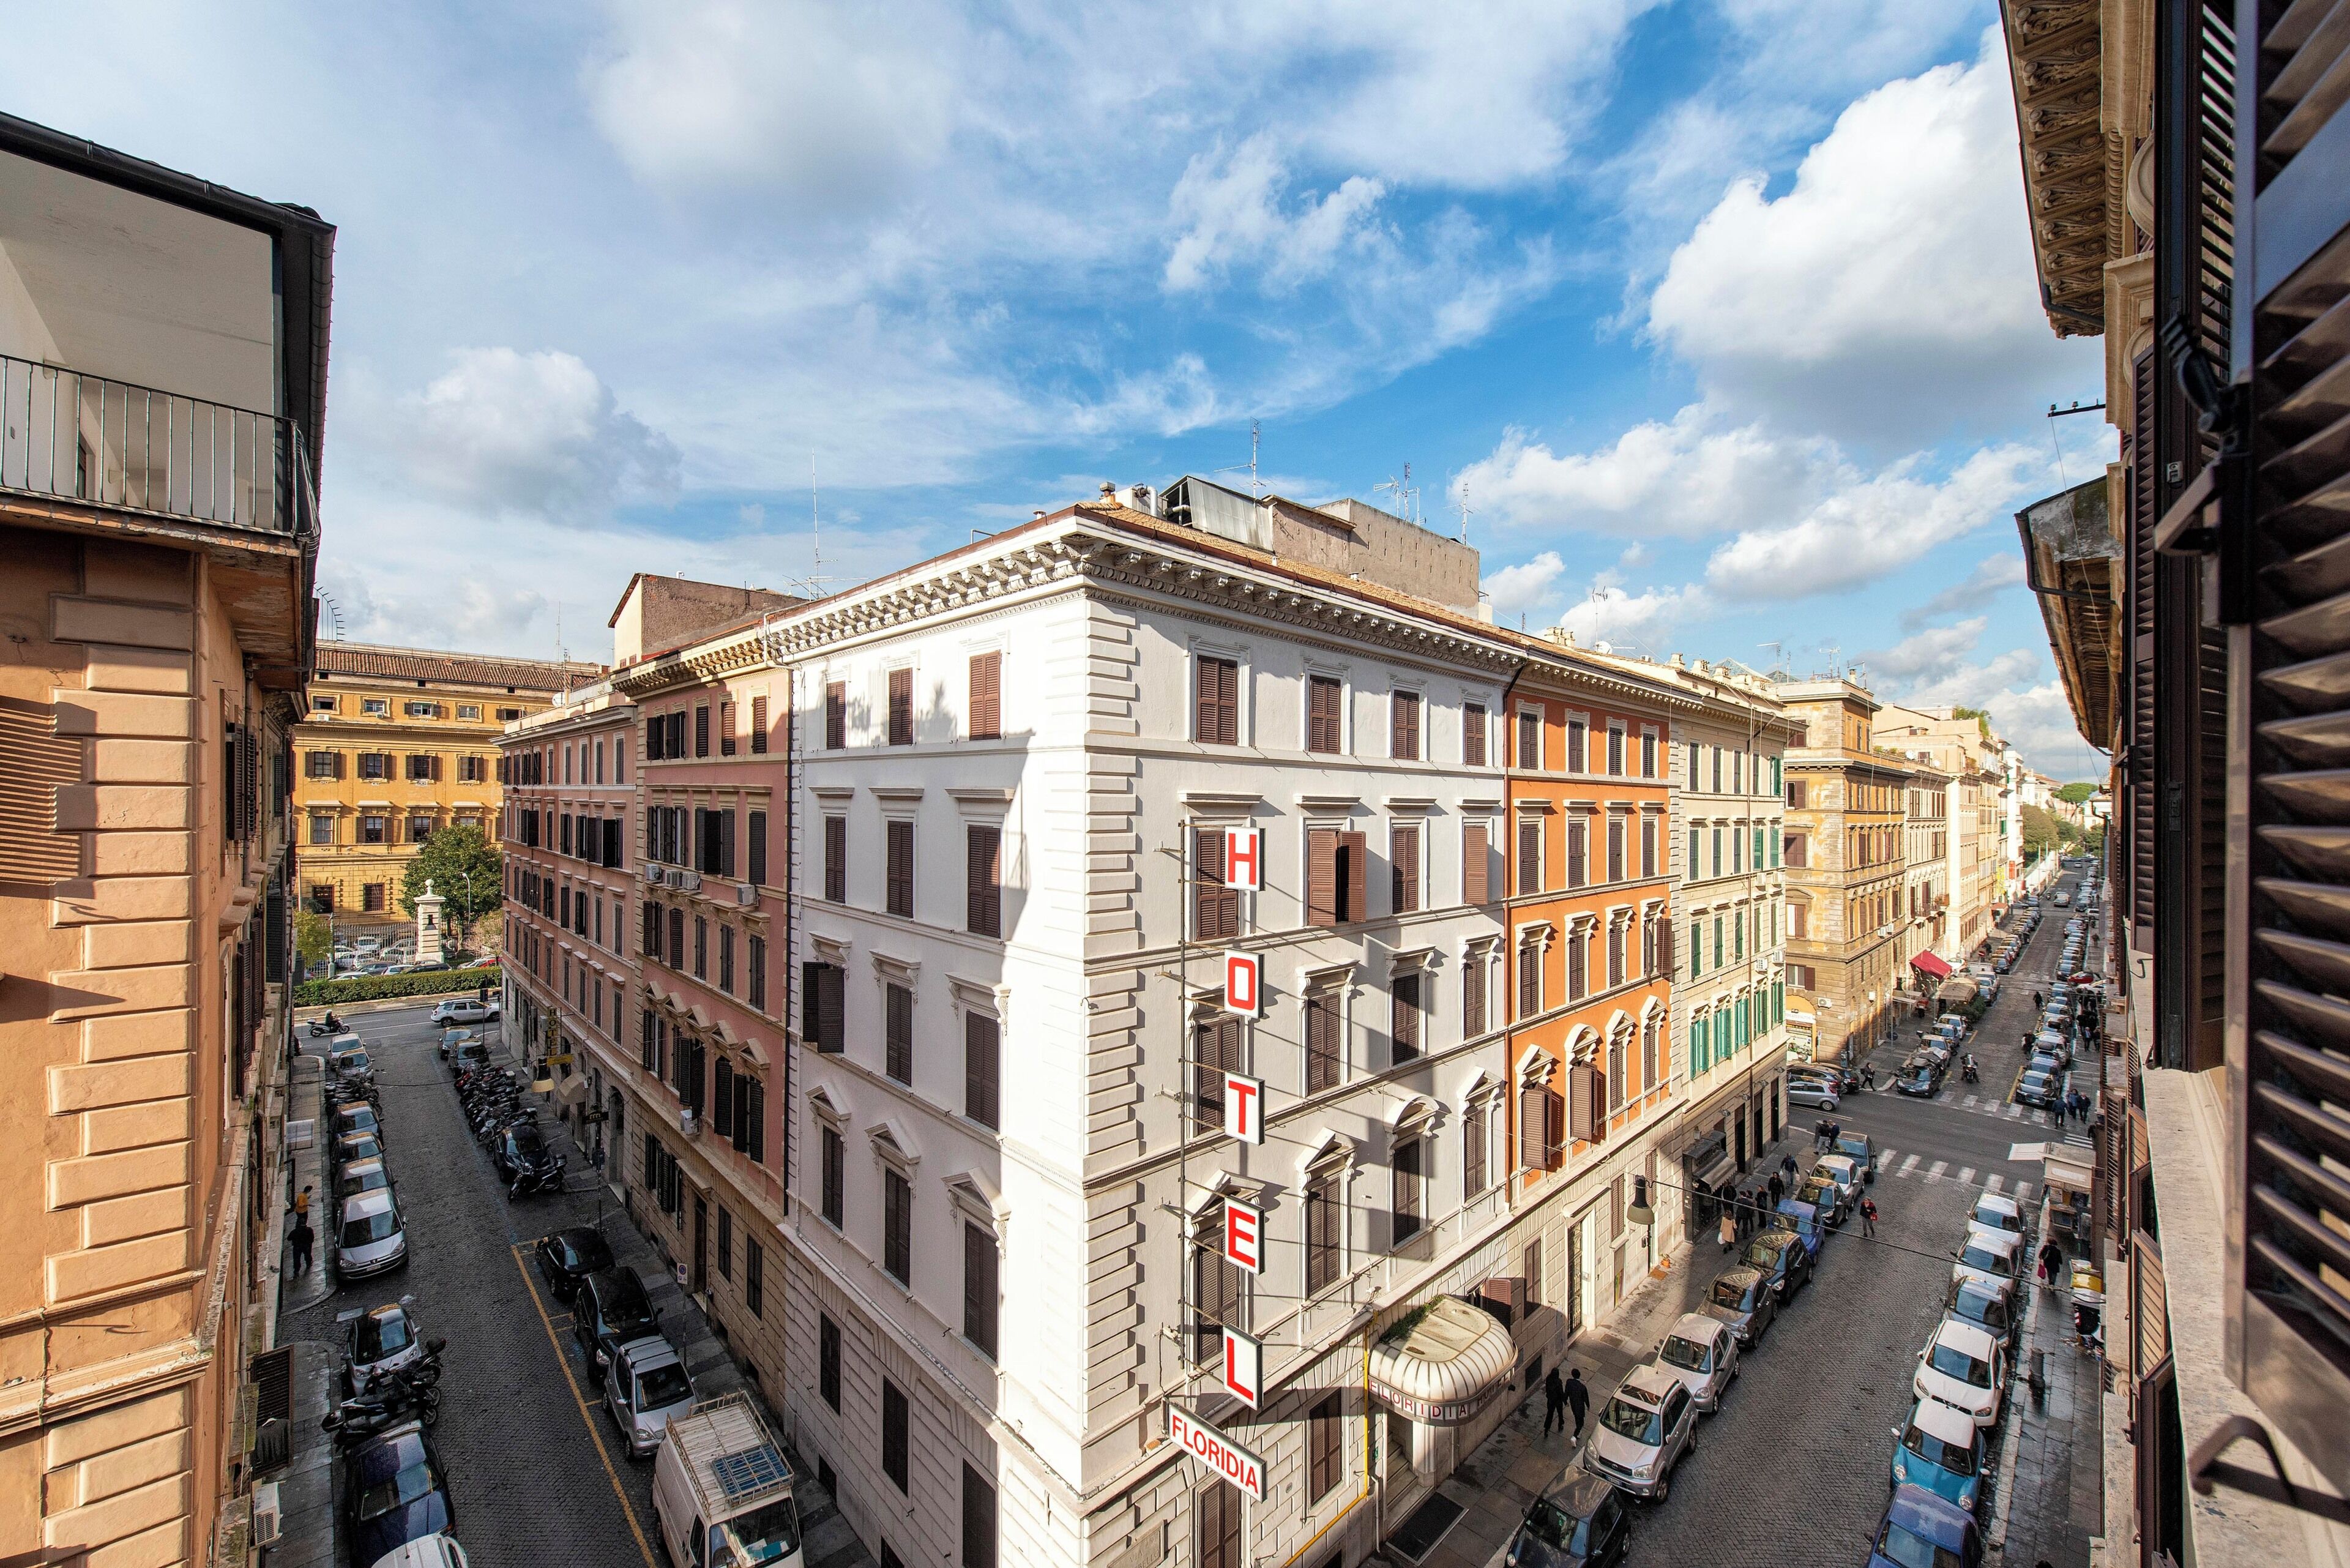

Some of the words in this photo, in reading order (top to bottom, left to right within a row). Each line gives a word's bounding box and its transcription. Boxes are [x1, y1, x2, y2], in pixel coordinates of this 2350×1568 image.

[549, 1009, 558, 1056] HOTEL
[1227, 832, 1257, 1402] HOTEL
[1370, 1380, 1468, 1417] FLORIDIA
[1172, 1414, 1259, 1494] FLORIDIA
[1135, 1550, 1159, 1568] BELLO
